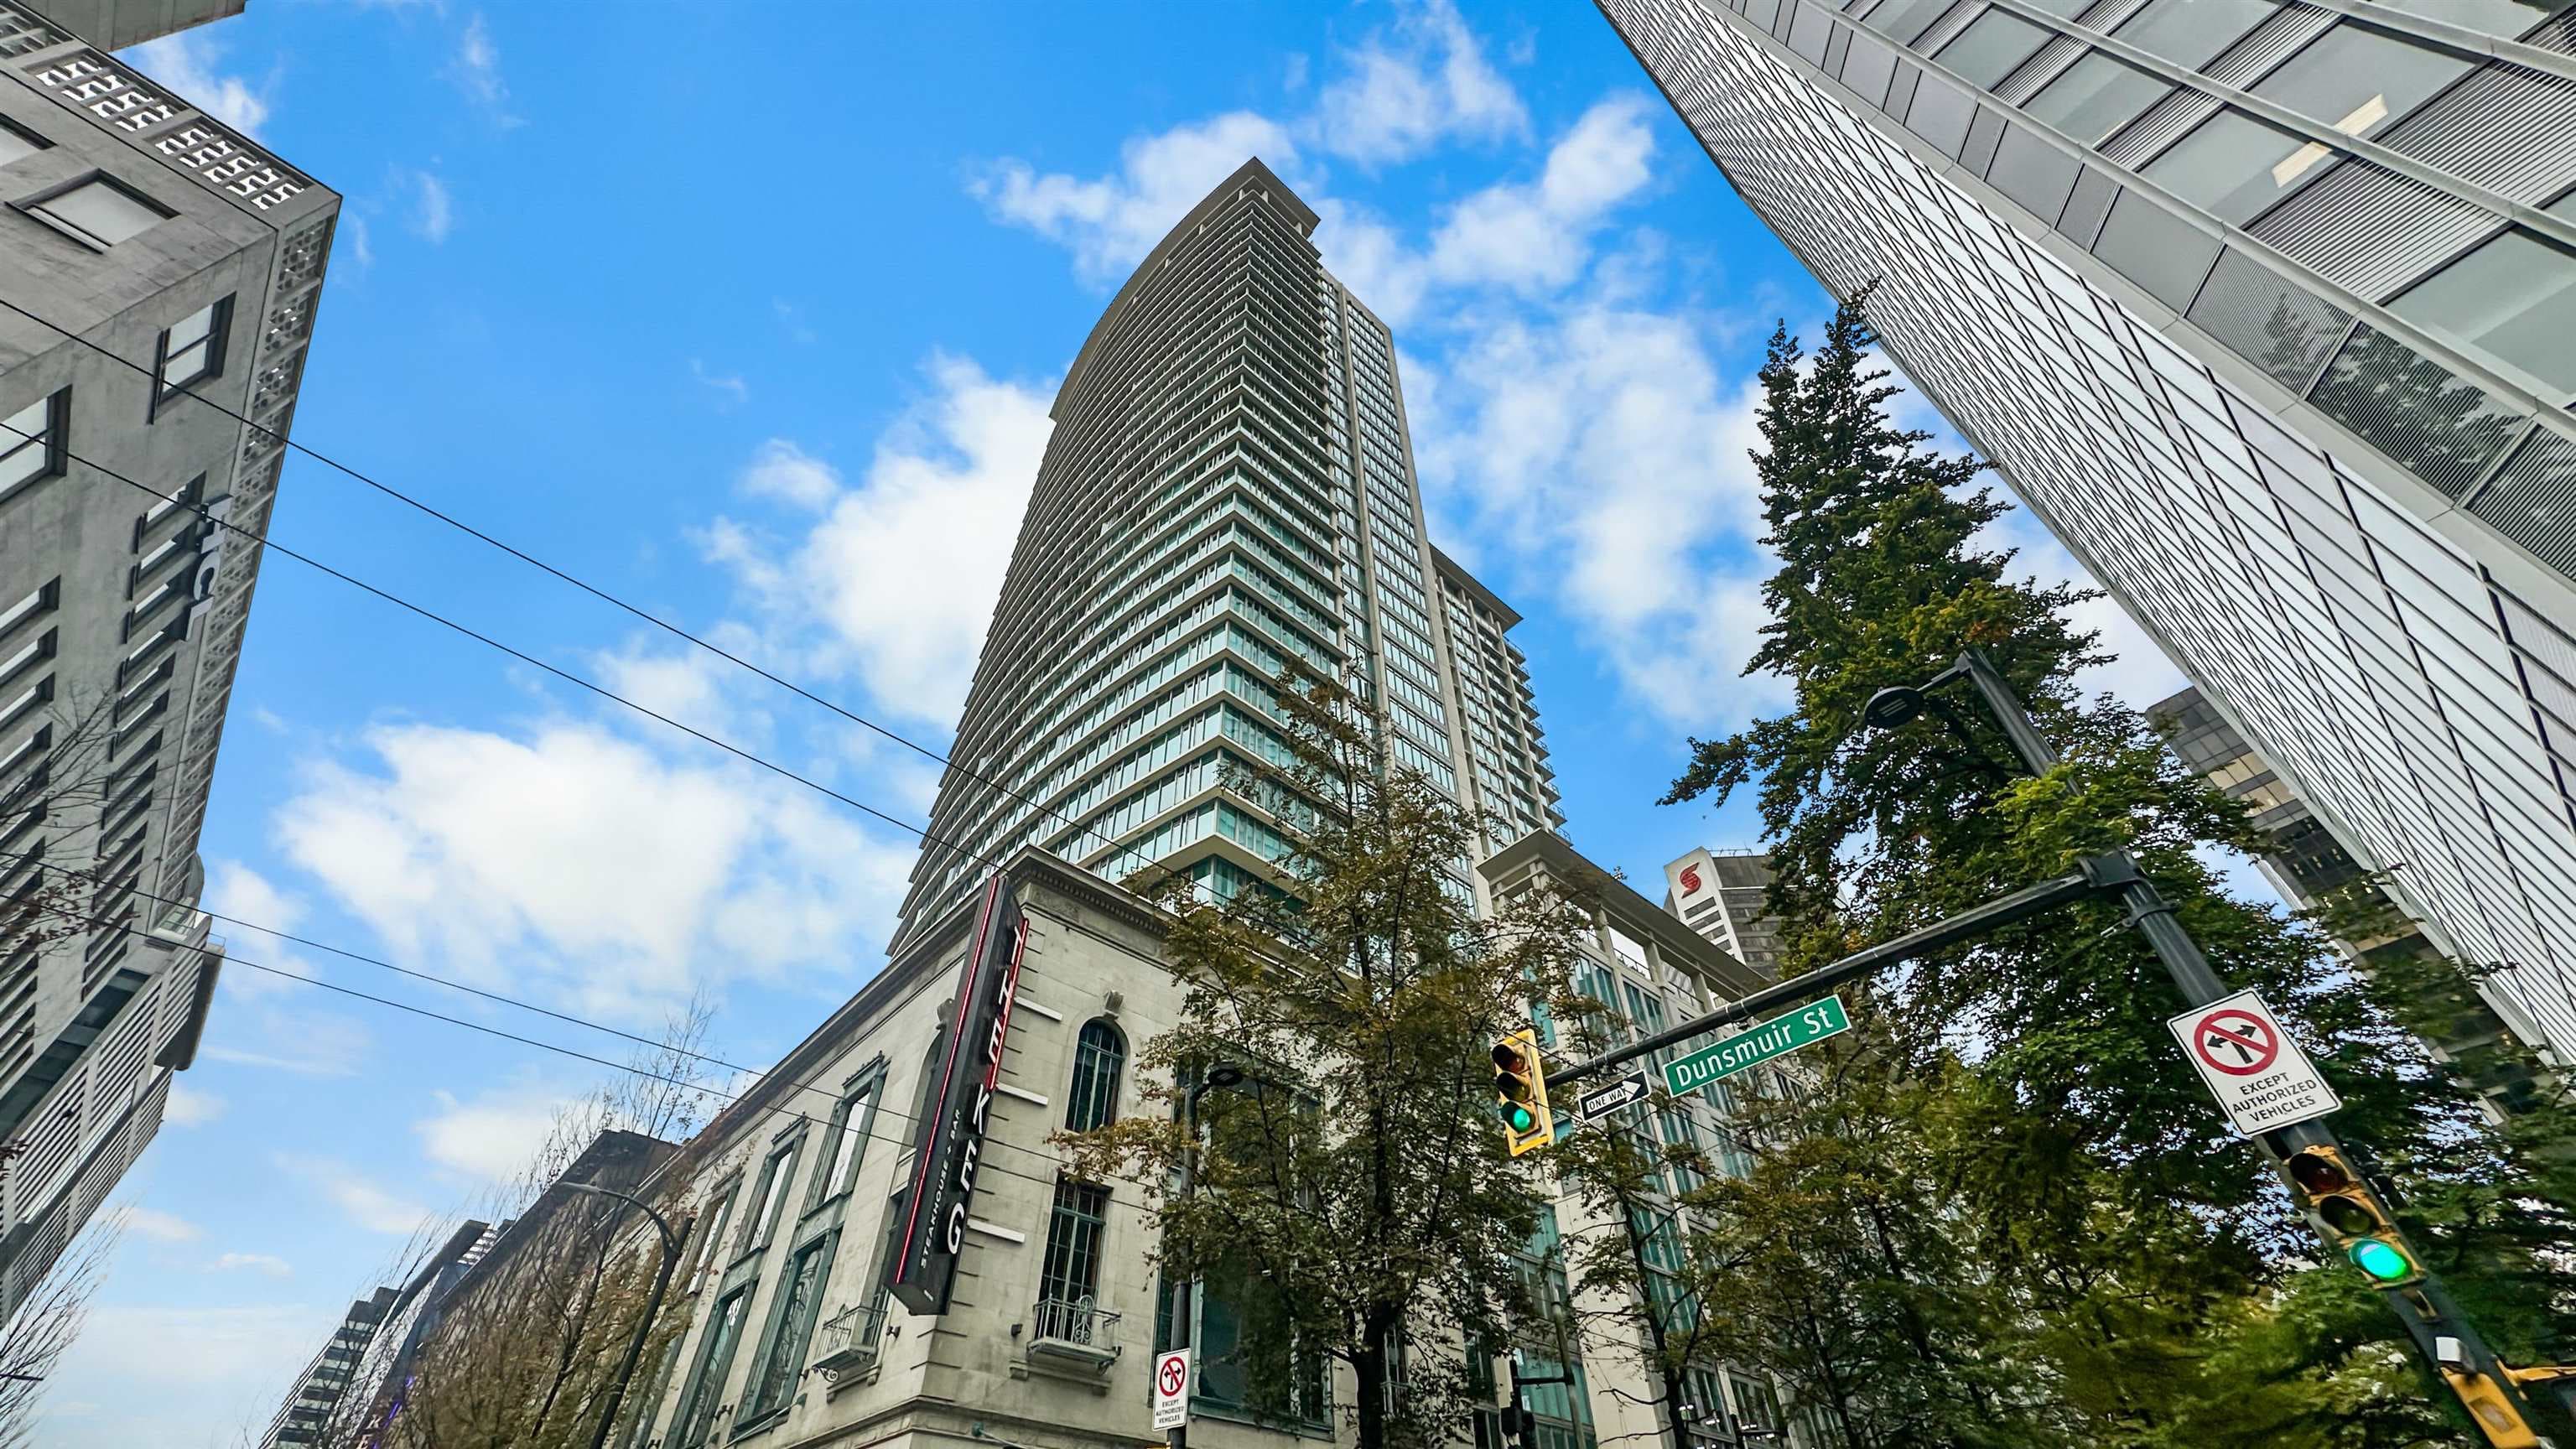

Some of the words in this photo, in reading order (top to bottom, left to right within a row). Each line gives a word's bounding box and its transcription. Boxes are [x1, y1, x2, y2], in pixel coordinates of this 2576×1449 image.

[185, 495, 234, 641] HCL
[988, 925, 1024, 1064] THE
[1676, 1024, 1793, 1088] Dunsmuir
[1803, 1006, 1834, 1036] St
[2240, 1072, 2289, 1096] EXCEPT
[1589, 1095, 1606, 1111] ONE
[2231, 1078, 2318, 1114] AUTHORIZED
[2249, 1094, 2317, 1123] VEHICLES
[920, 1160, 949, 1269] STEAKHOUSE
[950, 1109, 961, 1141] BAR
[947, 1083, 991, 1254] KEG
